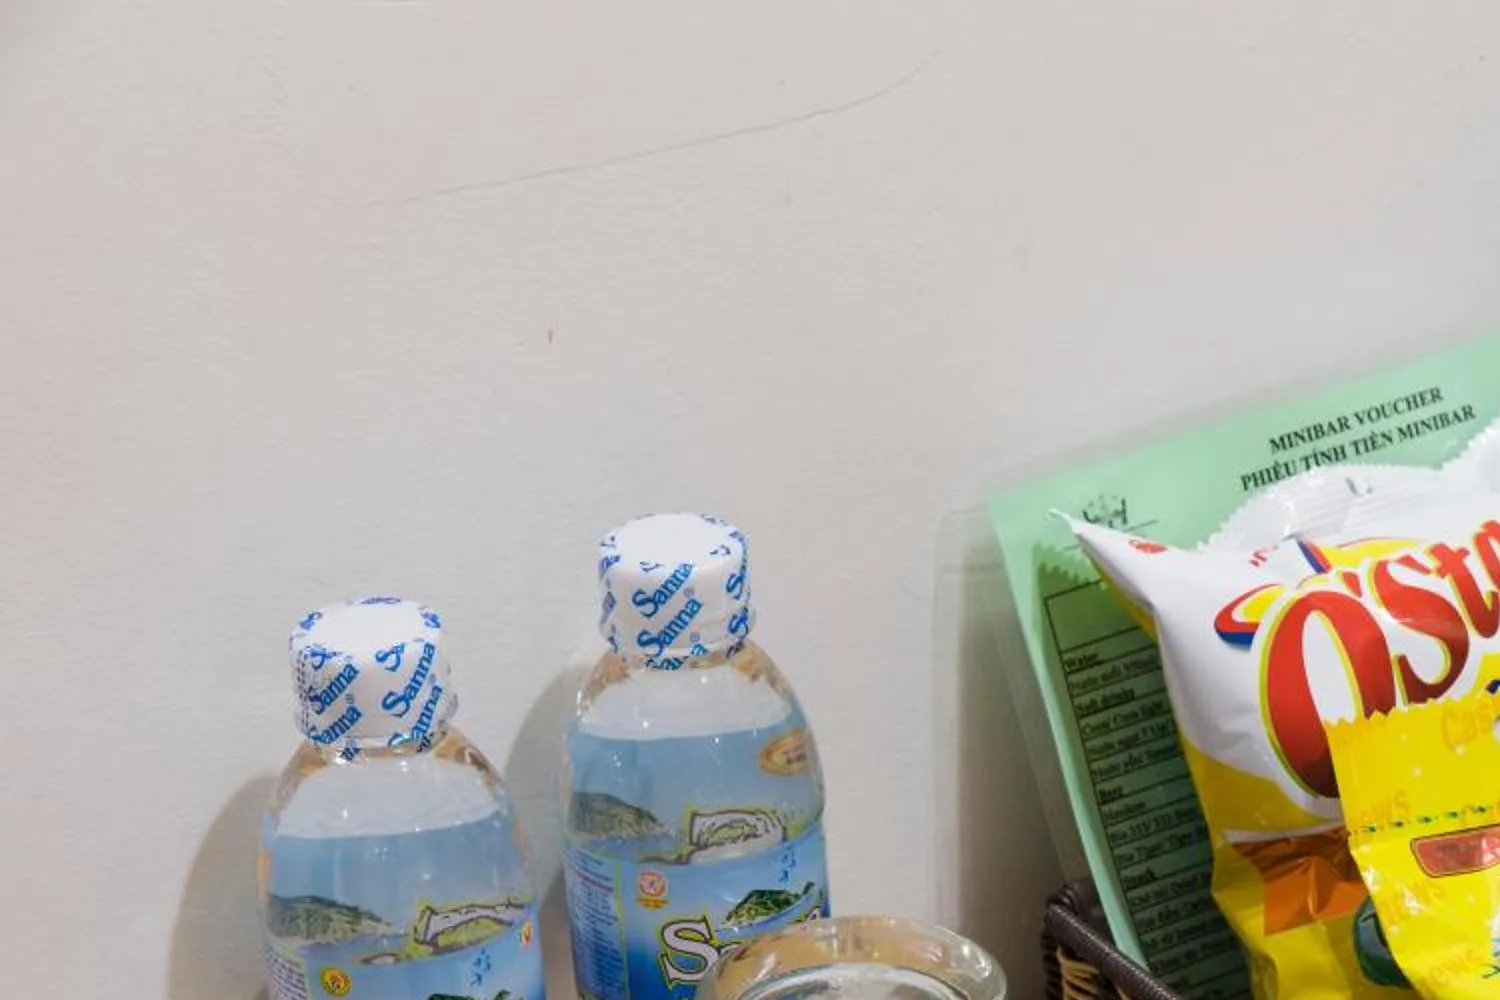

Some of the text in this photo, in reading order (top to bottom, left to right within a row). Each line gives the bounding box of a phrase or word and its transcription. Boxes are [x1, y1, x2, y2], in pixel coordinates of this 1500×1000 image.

[1268, 386, 1444, 454] MINIBAR VOUCHER
[1396, 403, 1477, 443] MINIBAR
[632, 562, 695, 618] Sanna
[637, 598, 704, 658] Sanna
[307, 664, 359, 715] Sanna
[381, 642, 436, 718] Sanna
